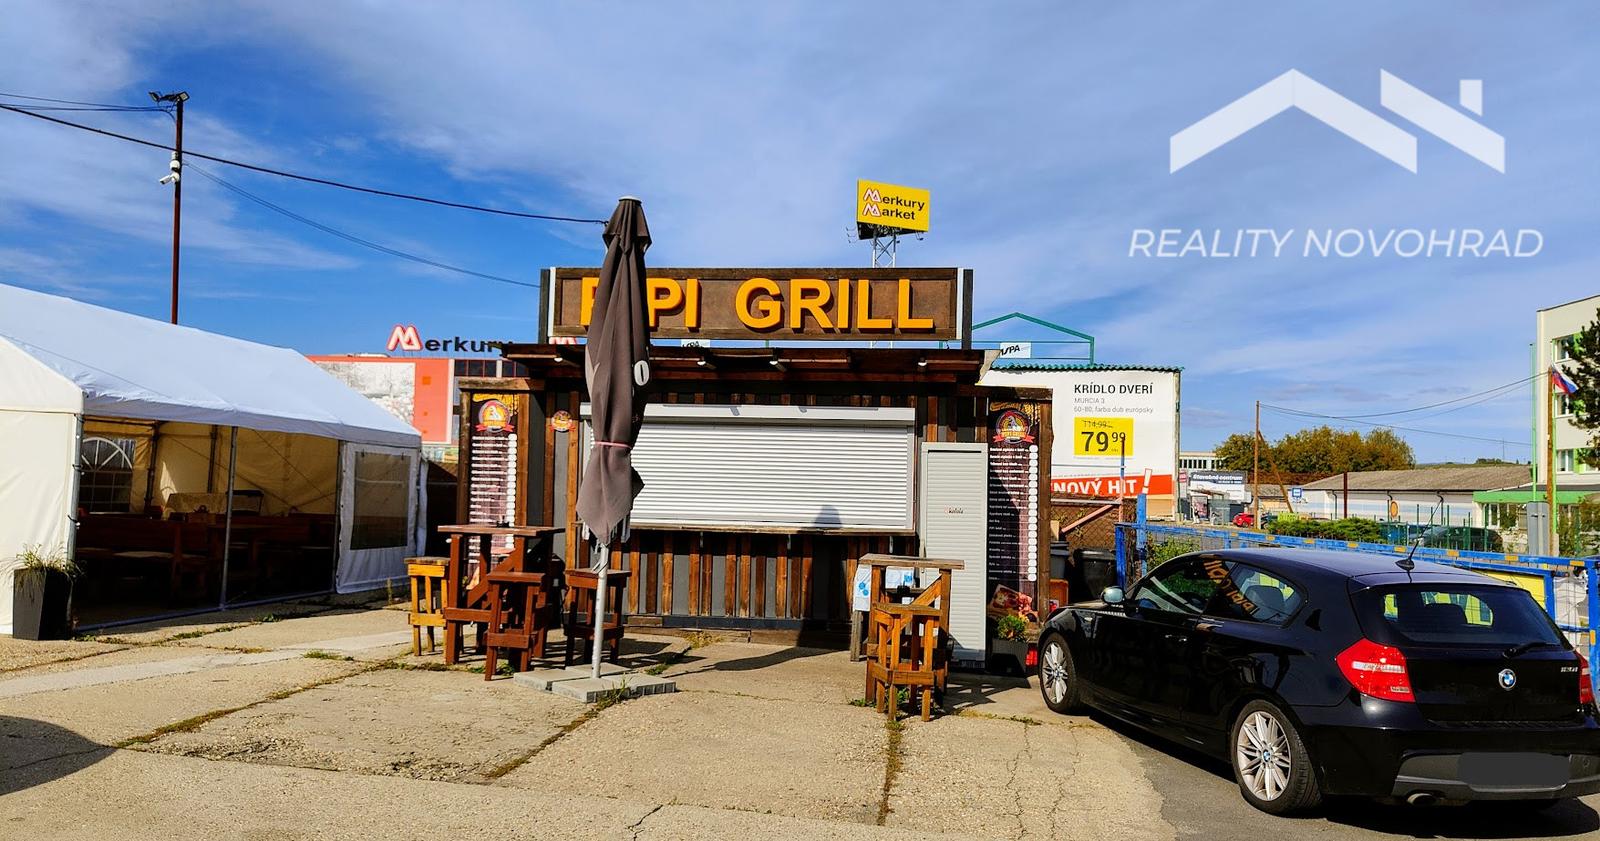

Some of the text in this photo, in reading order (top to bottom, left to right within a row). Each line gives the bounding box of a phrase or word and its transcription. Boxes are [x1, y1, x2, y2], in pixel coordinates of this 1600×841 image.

[863, 187, 925, 211] Merkury
[862, 202, 916, 220] Market
[735, 277, 934, 330] GRILL
[1074, 381, 1154, 394] KRÍDLO DVERÍ
[1081, 431, 1109, 452] 79
[1053, 478, 1102, 496] NOVÝ
